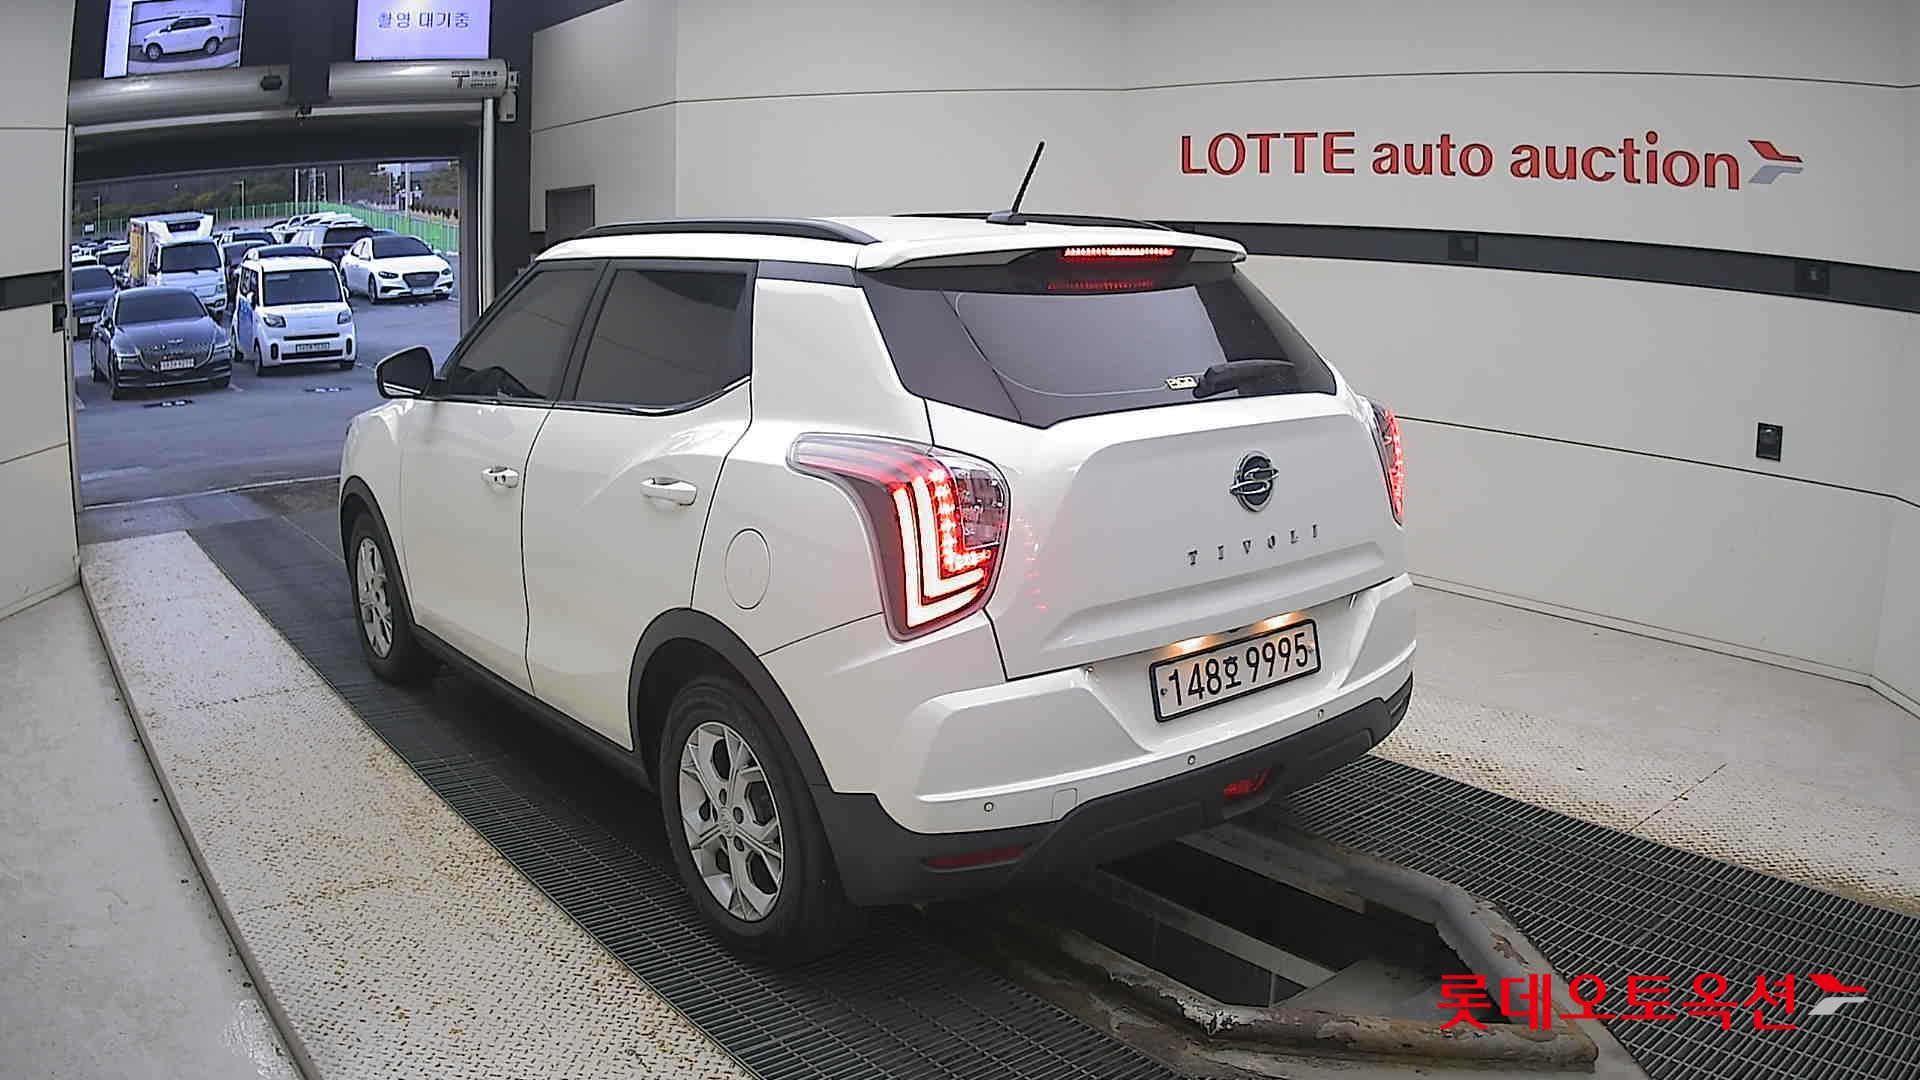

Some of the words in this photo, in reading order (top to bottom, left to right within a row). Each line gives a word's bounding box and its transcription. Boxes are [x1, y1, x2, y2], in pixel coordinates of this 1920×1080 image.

[418, 11, 471, 29] 대기중
[1182, 131, 1355, 175] LOTTE
[1373, 133, 1494, 177] auto
[1512, 130, 1740, 190] auction
[1187, 523, 1318, 566] TIVOLI
